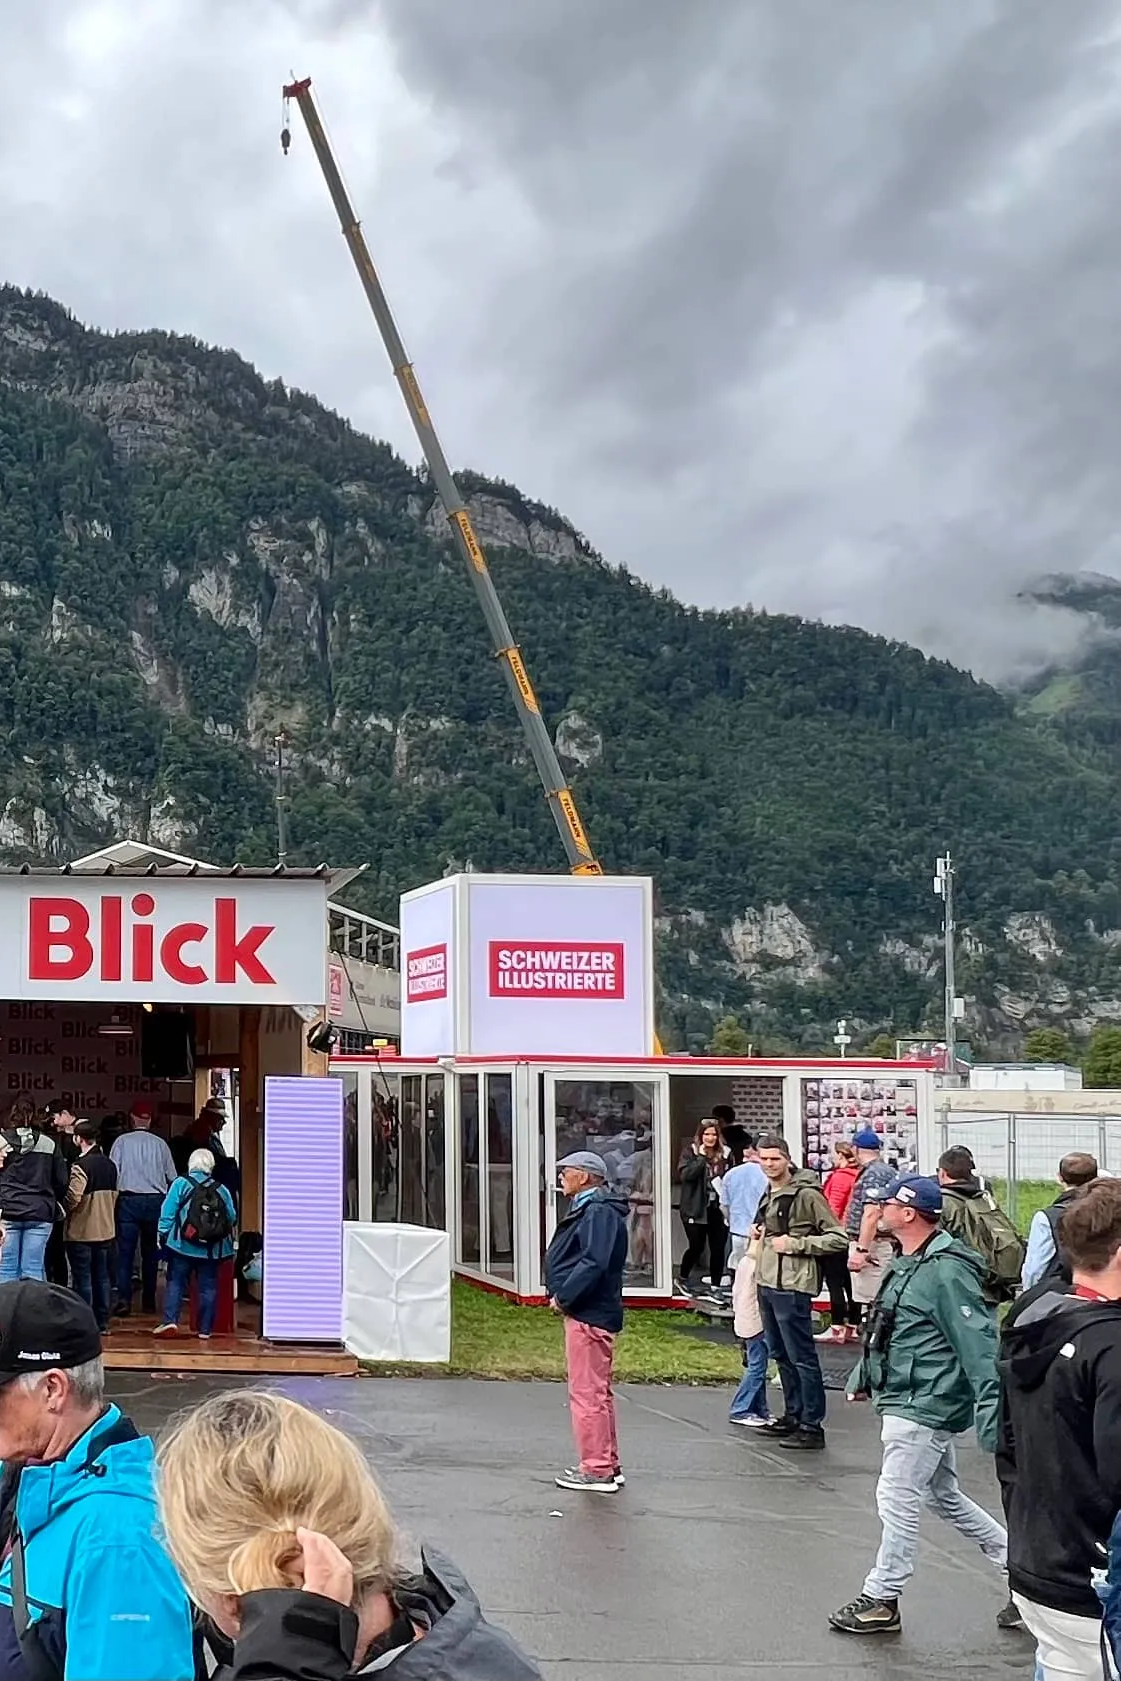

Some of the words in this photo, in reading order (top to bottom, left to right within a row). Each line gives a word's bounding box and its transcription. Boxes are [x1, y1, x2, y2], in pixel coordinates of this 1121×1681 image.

[511, 656, 529, 695] FELDMANN
[562, 798, 581, 838] FELDMANN
[29, 893, 277, 984] Blick
[498, 949, 616, 971] SCHWEIZER
[498, 972, 616, 990] ILLUSTRIERTE
[8, 1003, 55, 1019] Blick
[8, 1038, 55, 1055] Blick
[61, 1056, 108, 1073] Blick
[8, 1073, 54, 1090] Blick
